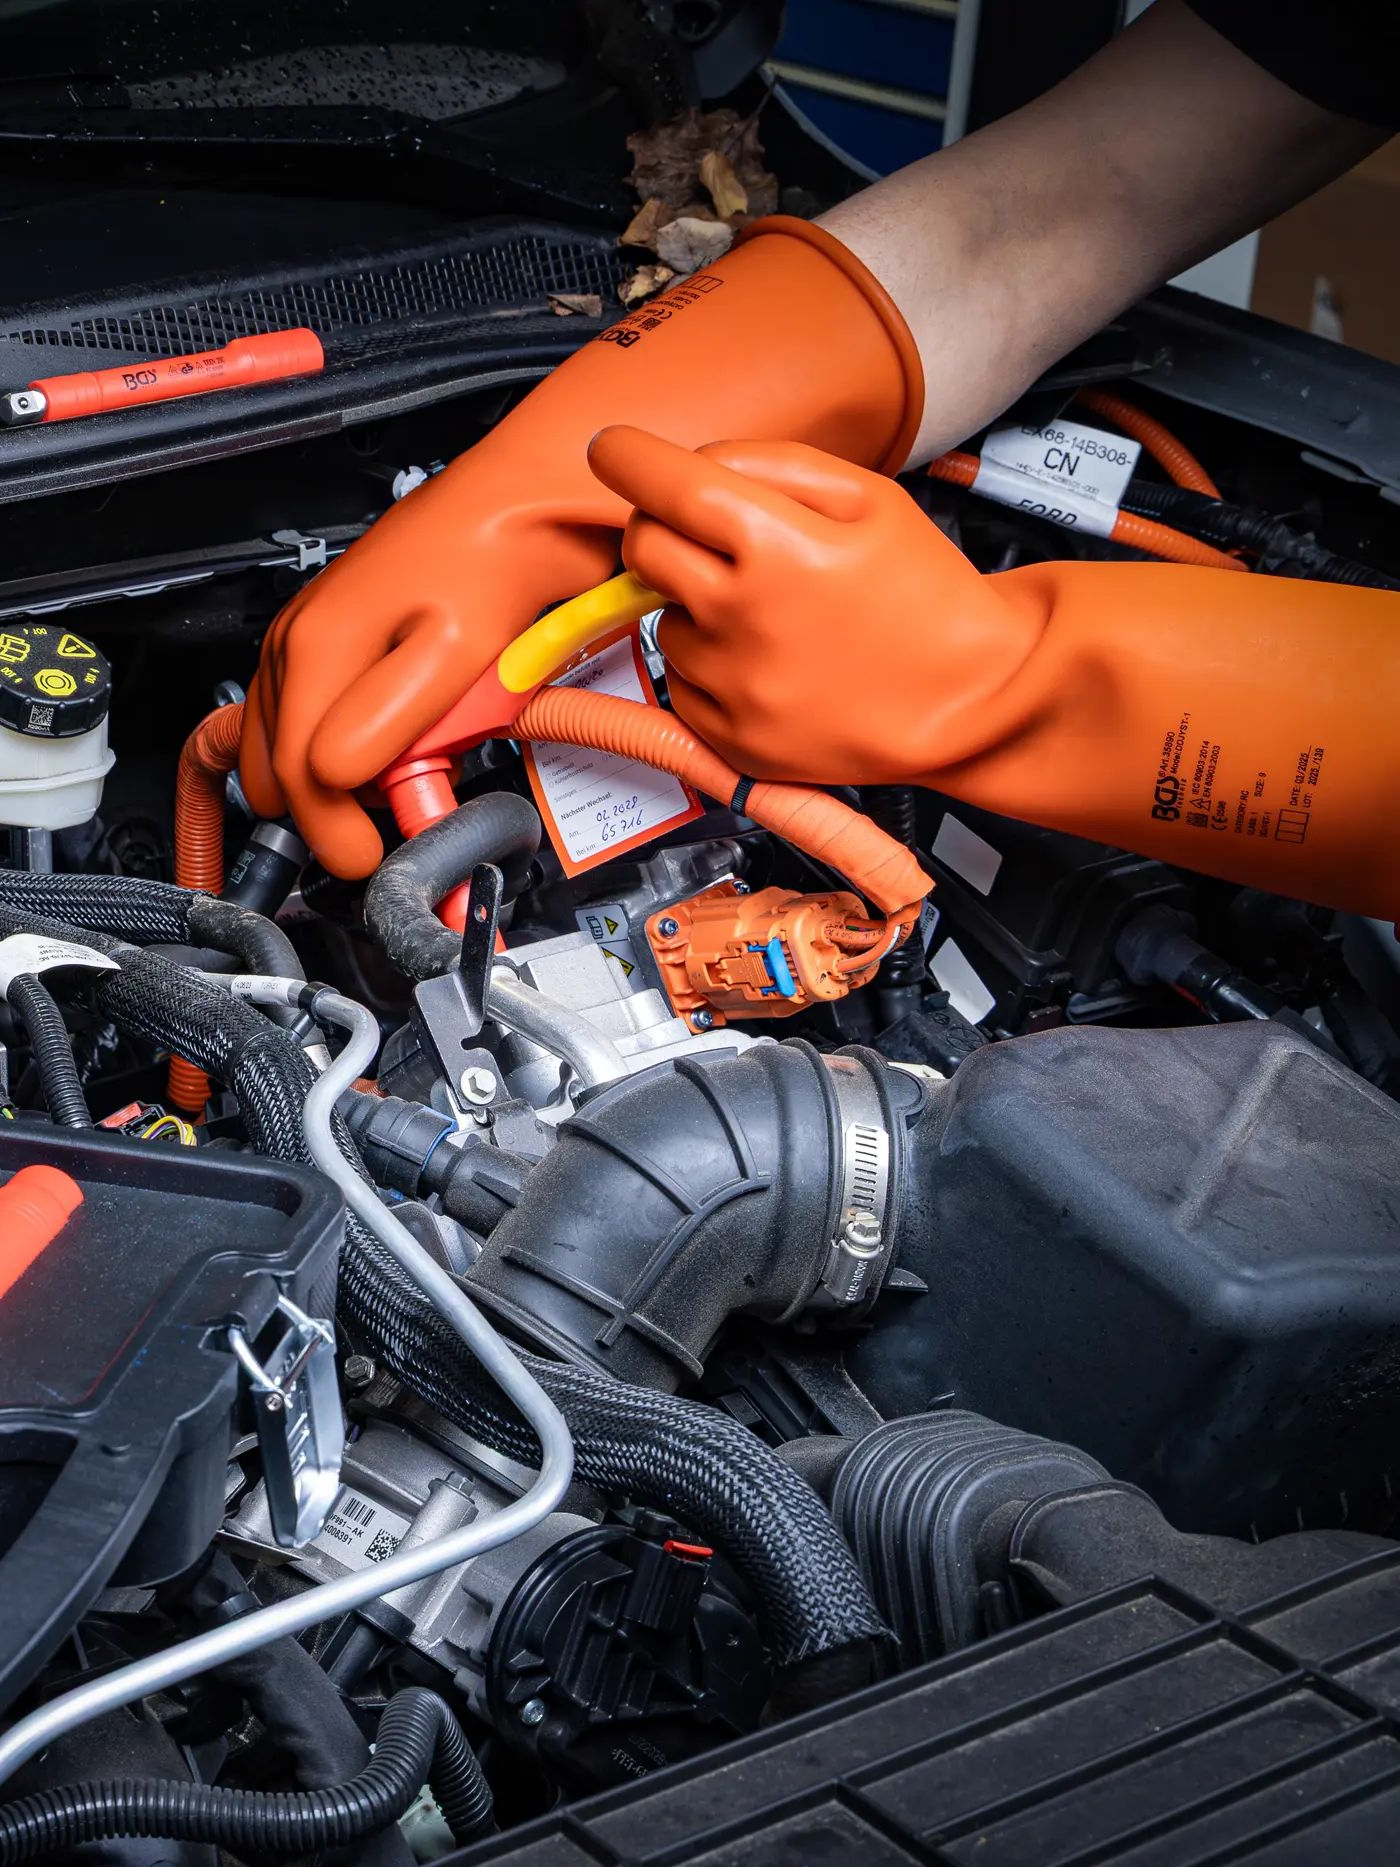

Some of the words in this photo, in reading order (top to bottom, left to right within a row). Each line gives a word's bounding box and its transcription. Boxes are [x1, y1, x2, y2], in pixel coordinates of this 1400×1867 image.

[122, 369, 157, 391] BGS
[1043, 447, 1080, 476] CN
[1016, 499, 1078, 526] FORD
[560, 804, 587, 821] Nächster
[586, 791, 613, 809] Wechsel:
[1151, 775, 1180, 822] BGS
